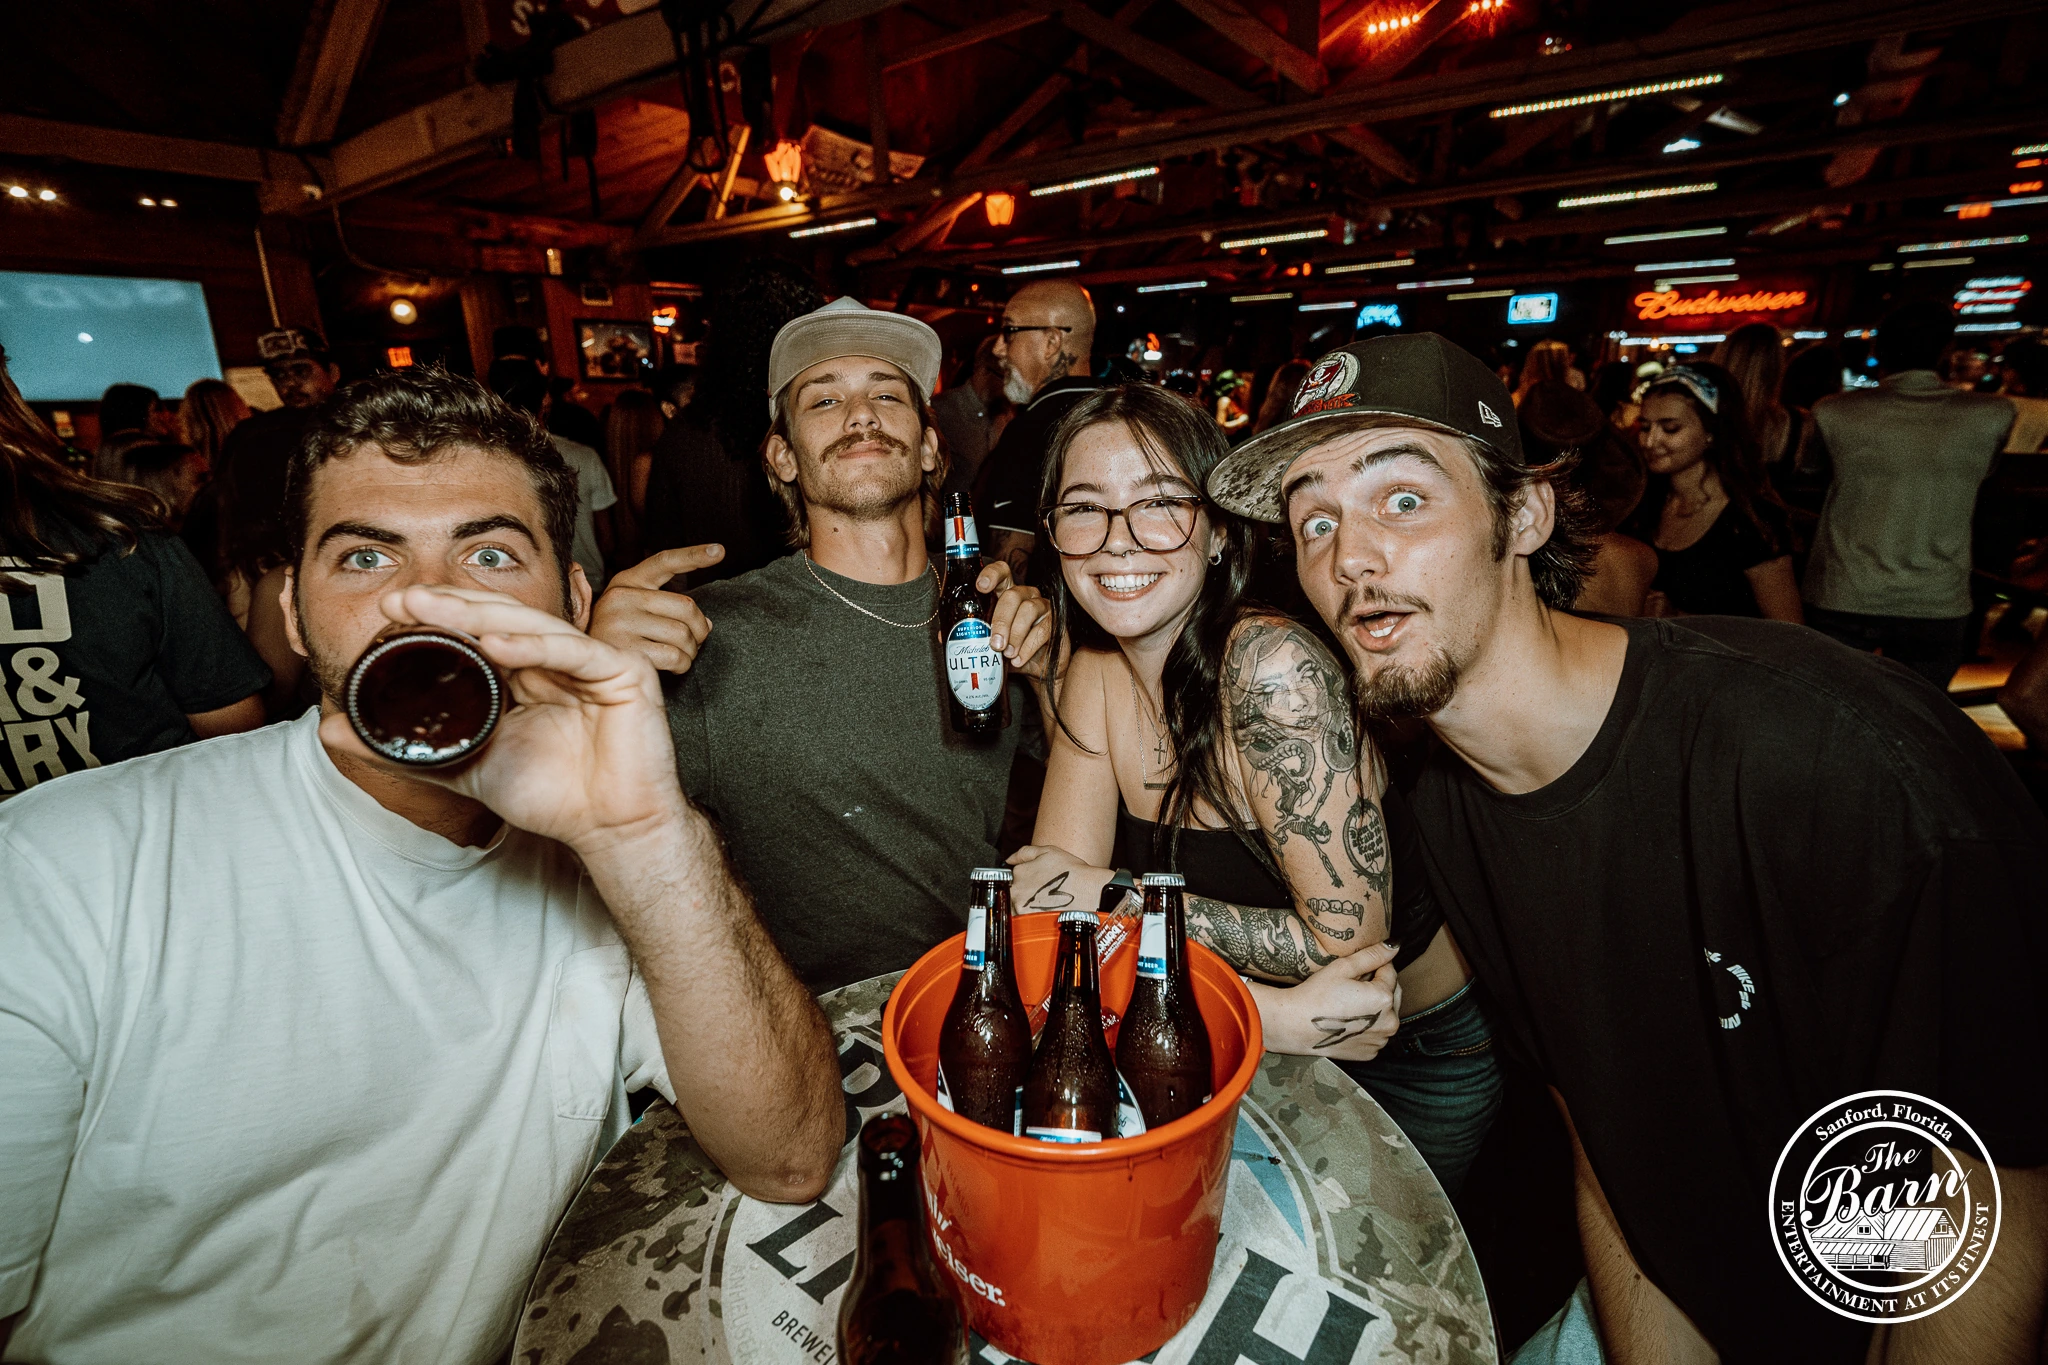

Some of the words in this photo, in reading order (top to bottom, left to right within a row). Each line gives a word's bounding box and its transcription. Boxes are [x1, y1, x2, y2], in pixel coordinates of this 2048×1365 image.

[1634, 290, 1807, 320] Budweiser
[949, 654, 1001, 671] ULTRA
[0, 711, 102, 790] RY
[1726, 965, 1755, 994] NIKE
